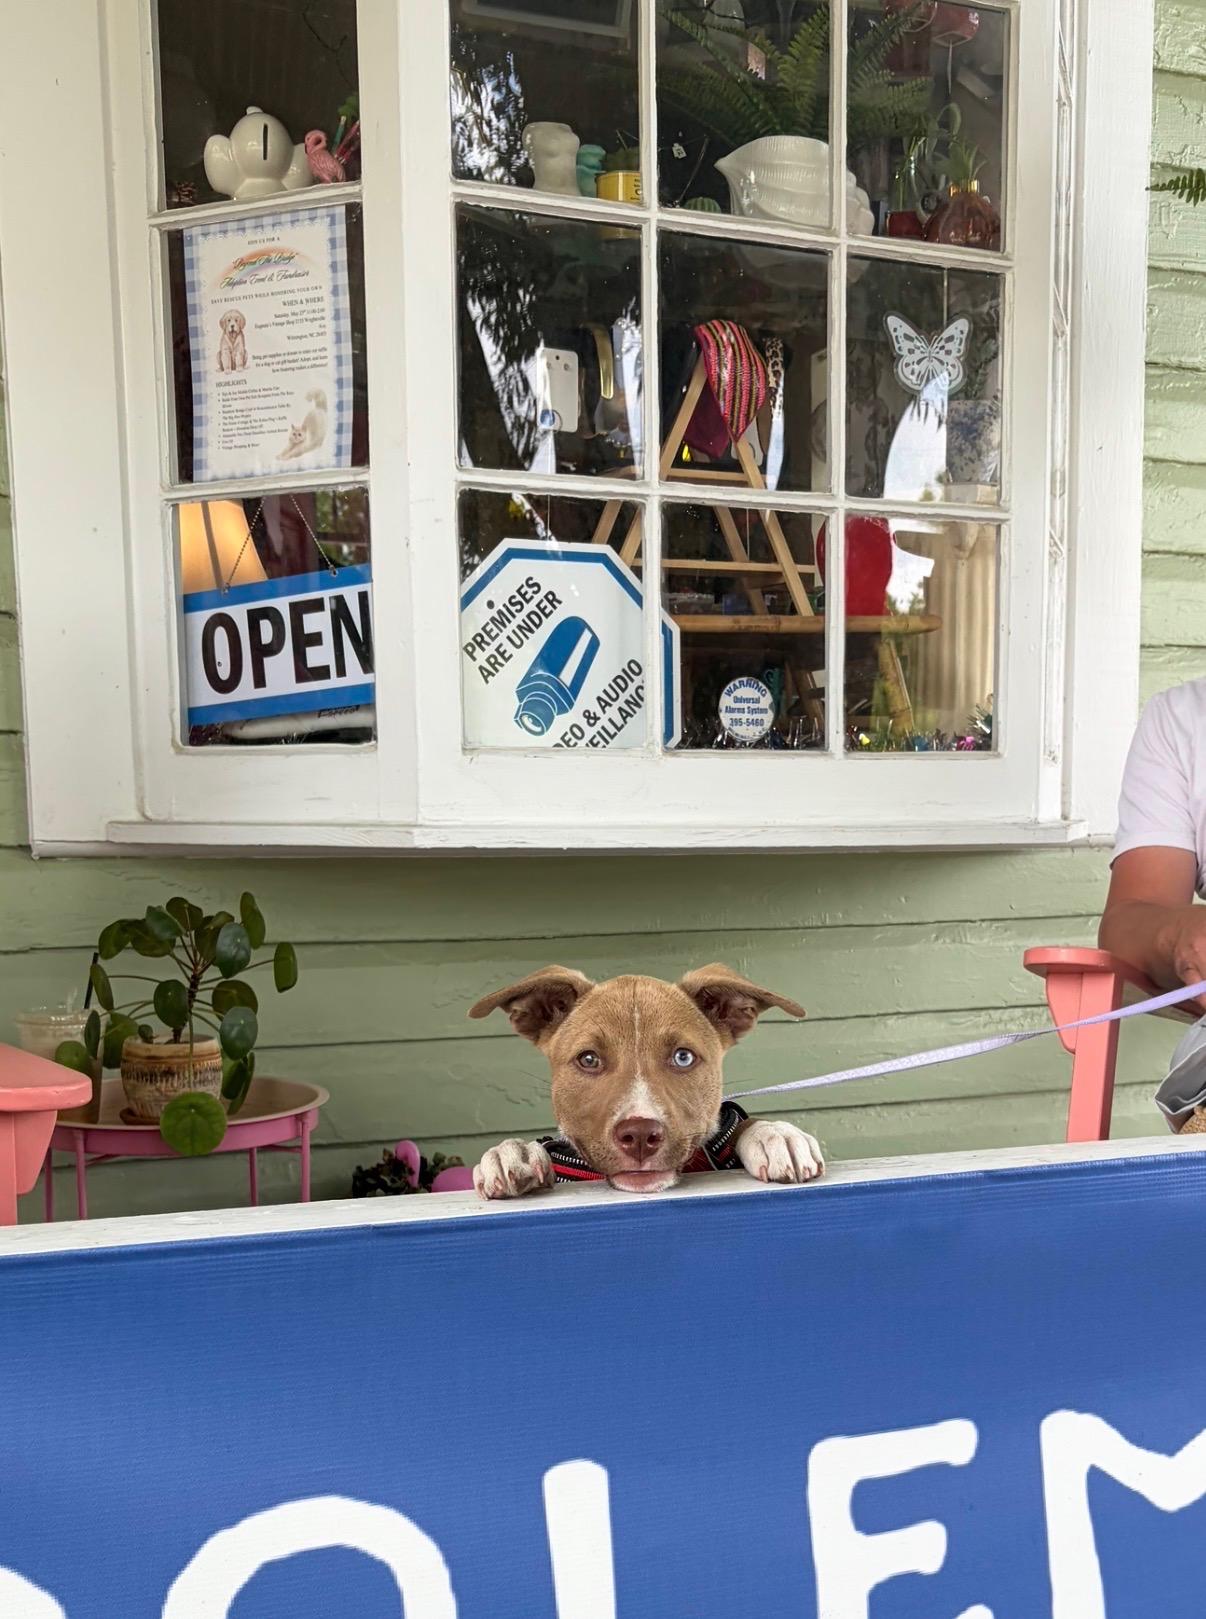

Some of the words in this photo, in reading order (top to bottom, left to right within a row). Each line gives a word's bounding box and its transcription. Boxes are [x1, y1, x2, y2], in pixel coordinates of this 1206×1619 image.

[249, 273, 267, 285] Event
[267, 273, 274, 282] &
[305, 296, 324, 305] WHERE
[216, 379, 247, 388] HIGHLIGHTS
[462, 576, 542, 662] PREMISES
[202, 590, 374, 695] OPEN
[478, 646, 514, 685] ARE
[508, 590, 563, 650] UNDER
[724, 679, 768, 697] WARNING
[552, 723, 585, 747] EO
[582, 709, 601, 727] &
[596, 659, 643, 714] AUDIO
[733, 696, 760, 704] Universal
